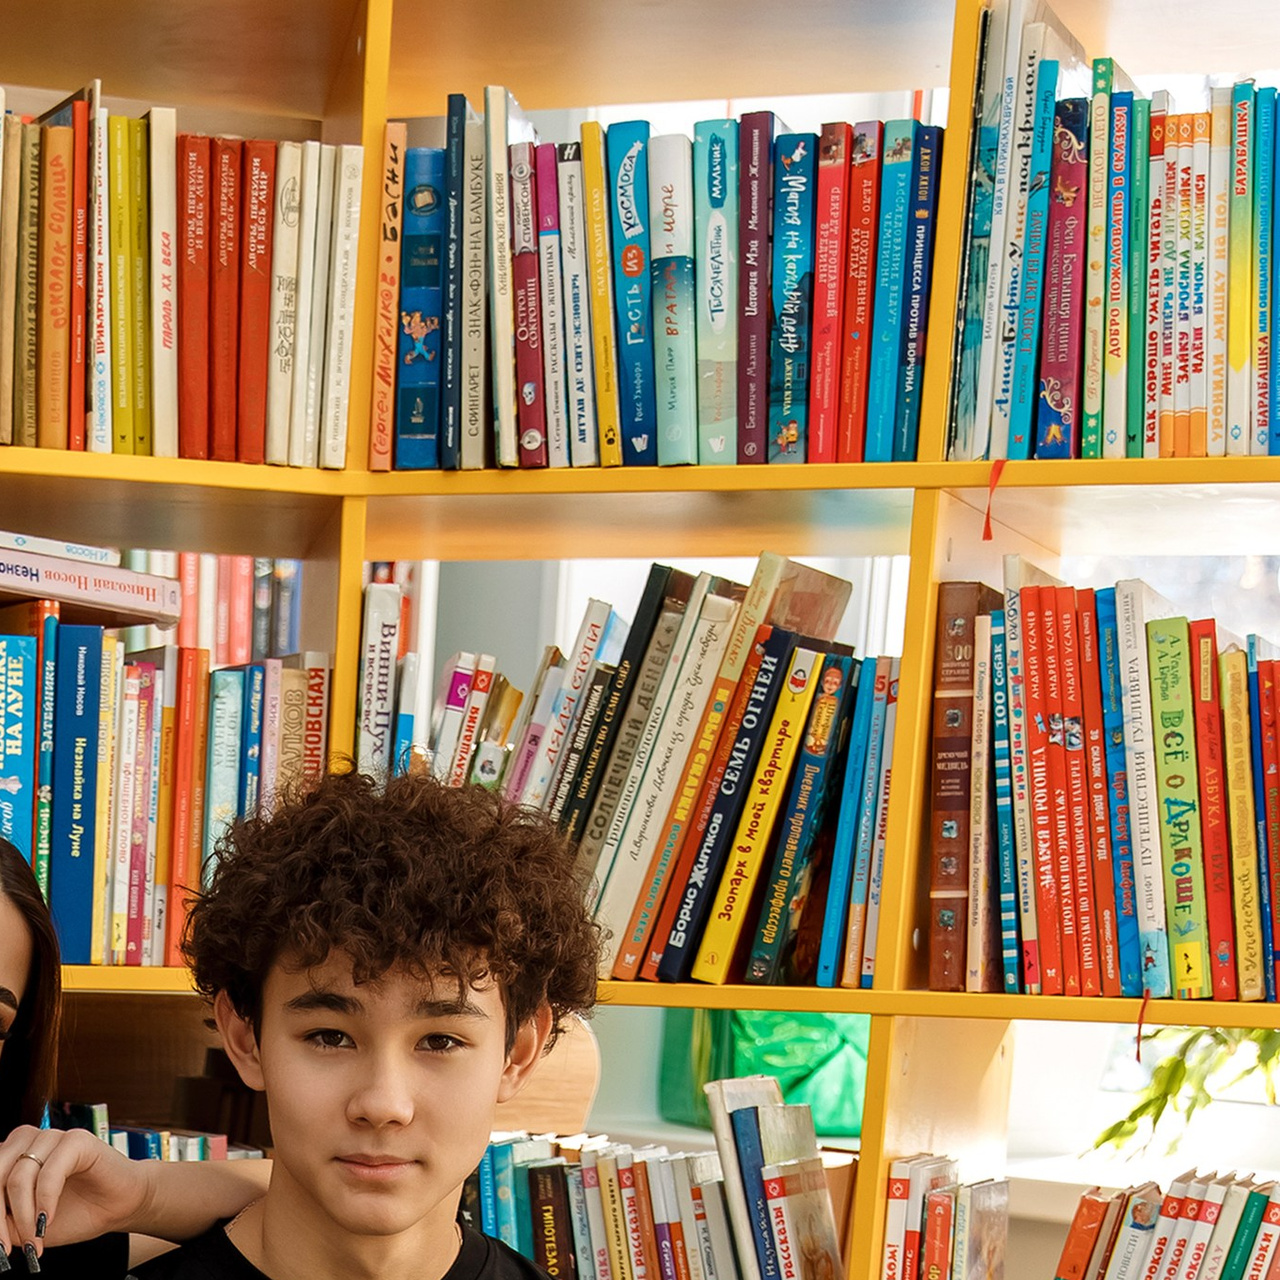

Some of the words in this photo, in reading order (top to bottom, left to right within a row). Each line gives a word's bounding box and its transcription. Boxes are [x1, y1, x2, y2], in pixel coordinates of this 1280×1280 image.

[1112, 107, 1127, 171] СКАЗКУ!
[1235, 101, 1249, 195] БАРАБАШКА
[471, 154, 483, 224] БАМБУКЕ
[521, 183, 531, 243] СТИВЕНСОН
[1112, 178, 1125, 186] В
[162, 232, 171, 265] ВЕКА
[470, 229, 482, 250] НА
[911, 225, 925, 292] ПРИНЦЕССА
[1110, 191, 1125, 302] ПОЖАЛОВАТЬ
[162, 300, 172, 349] ПАРОЛЬ
[469, 299, 481, 338] ЗНАК
[526, 278, 538, 348] СОКРОВИЩ
[908, 295, 920, 339] ПРОТИВ
[1109, 308, 1122, 357] ДОБРО
[904, 342, 917, 392] ВОРЧУНА
[1258, 336, 1269, 427] БАРАБАШКА
[44, 568, 87, 590] Носов
[90, 576, 157, 601] Николай
[7, 656, 23, 718] ЛУНЕ
[994, 692, 1006, 727] 100
[1127, 657, 1144, 742] ГУЛЛИВЕРА
[7, 723, 22, 755] НА
[550, 753, 581, 821] ПРИКЛЮЧЕНИЯ
[573, 685, 603, 749] ЭЛЕКТРОНИКА
[577, 726, 608, 798] КОРОЛЕВСТВО
[602, 693, 619, 721] СЕМИ
[612, 660, 630, 688] ОЗЁР
[589, 719, 643, 839] СОЛНЕЧНЫЙ
[633, 639, 671, 711] ДЕНЁК
[720, 737, 753, 794] СЕМЬ
[740, 655, 778, 729] ОГНЕЙ
[1160, 710, 1186, 764] ВСЁ
[795, 764, 820, 809] Дневник
[1133, 752, 1151, 865] ПУТЕШЕСТВИЯ
[717, 860, 750, 921] Зоопарк
[742, 802, 767, 840] моей
[756, 719, 791, 794] квартире
[779, 813, 808, 876] пропавшего
[669, 890, 701, 947] Борис
[686, 814, 723, 886] Житков
[762, 880, 791, 943] профессора
